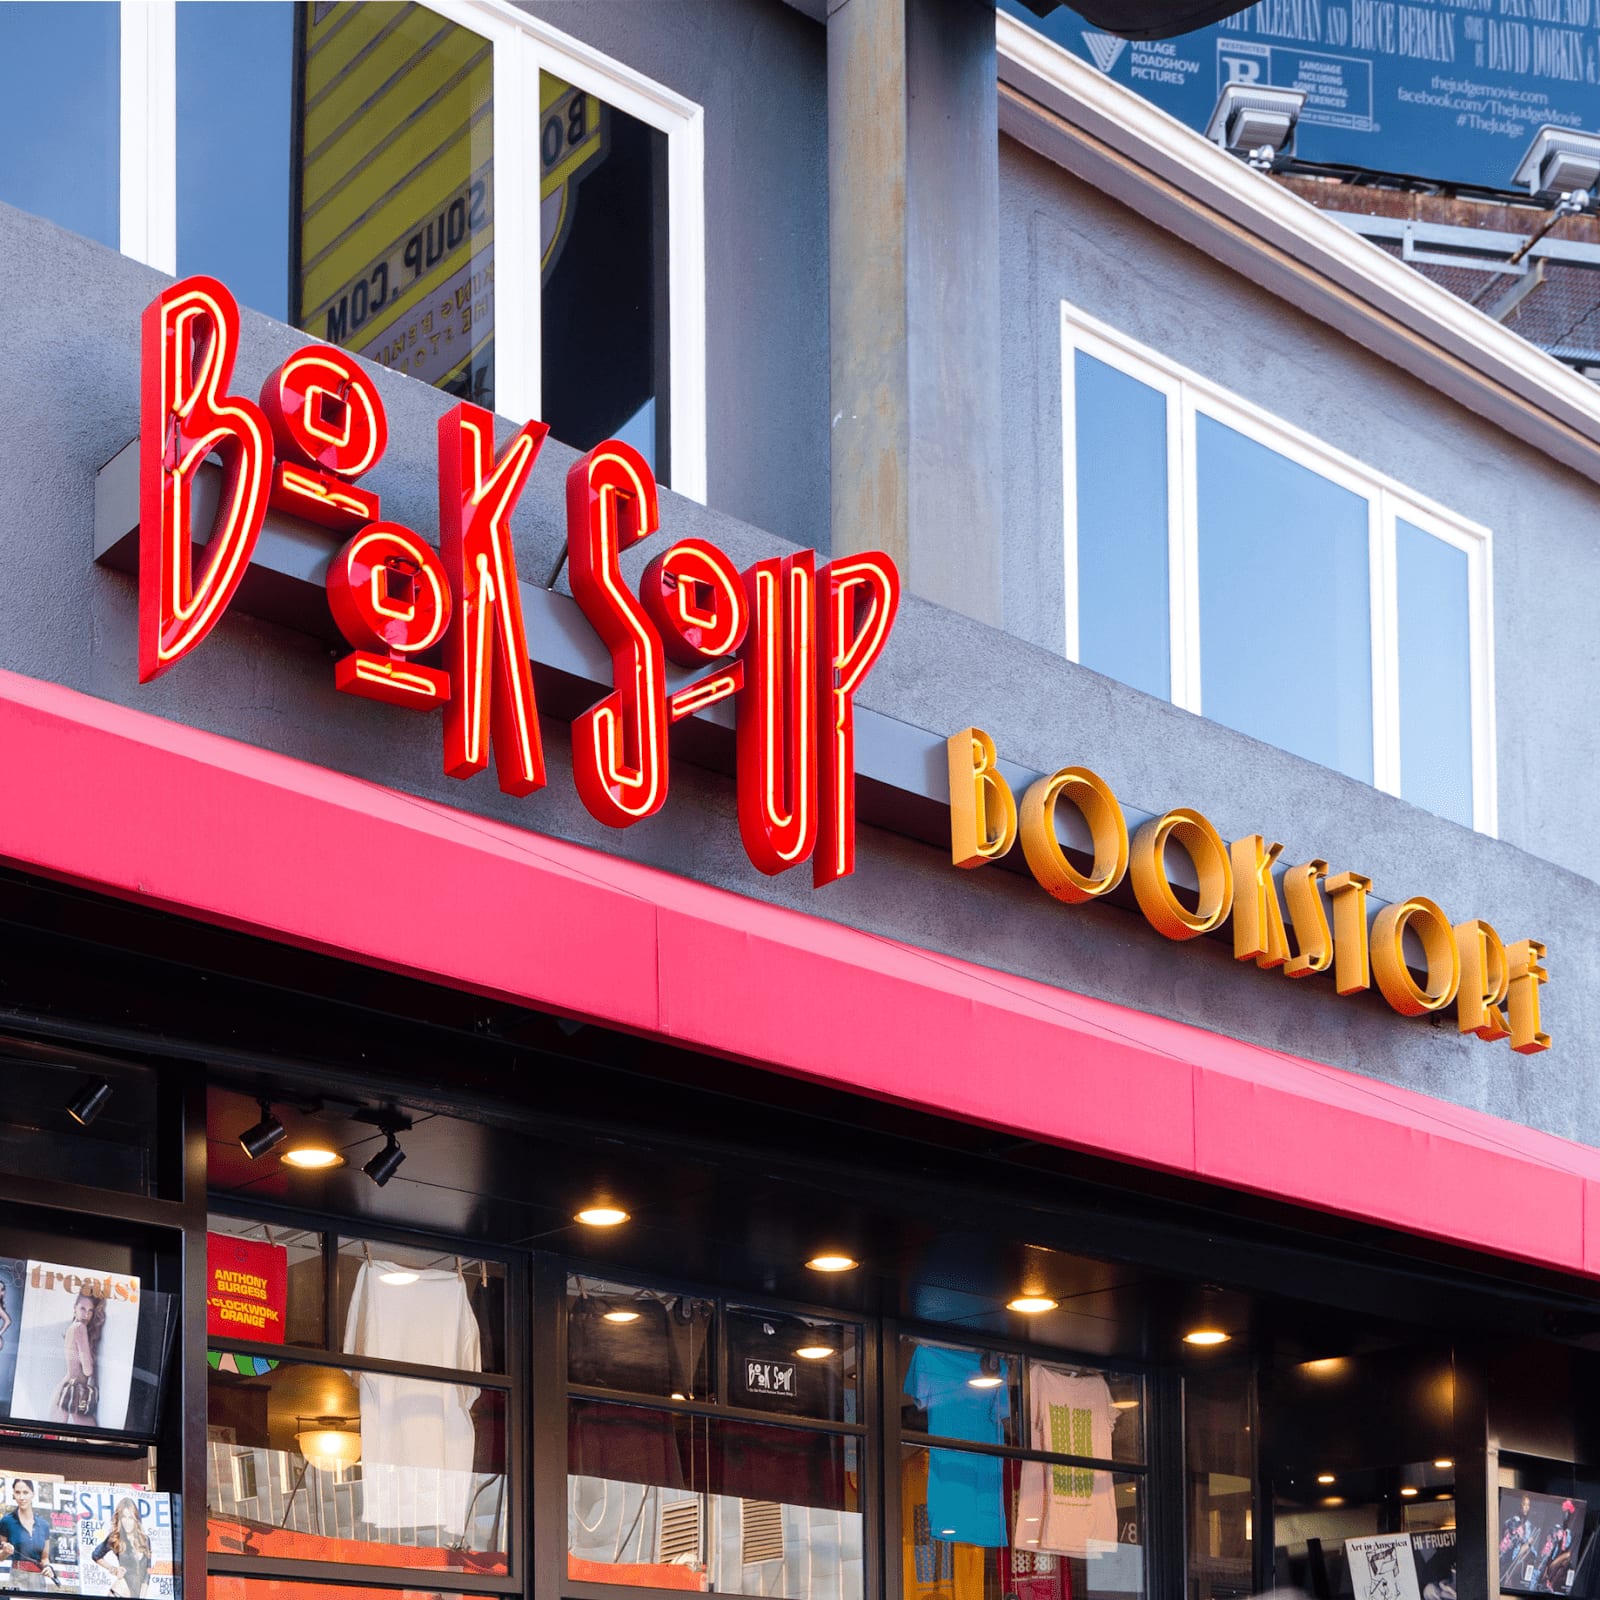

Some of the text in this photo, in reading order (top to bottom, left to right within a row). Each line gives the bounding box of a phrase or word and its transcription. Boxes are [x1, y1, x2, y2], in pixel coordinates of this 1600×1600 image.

[1351, 0, 1396, 54] BRUCE
[1398, 4, 1456, 63] BERMAN
[1130, 40, 1177, 56] VILLAGE
[1488, 19, 1529, 74] DAVID
[1533, 25, 1584, 82] DOBKIN
[1130, 52, 1200, 73] ROADSHOW
[1299, 60, 1342, 74] LANGUAGE
[1130, 66, 1185, 85] PICTURES
[1298, 71, 1343, 86] INCLUDING
[1318, 83, 1348, 97] SEXUAL
[1431, 75, 1549, 104] thejudgemovie.com
[946, 726, 1553, 1056] BOOKSTORE
[30, 1264, 139, 1304] treats!
[214, 1269, 268, 1289] ANTHONY
[217, 1280, 268, 1300] BURGESS
[211, 1297, 280, 1322] CLOCKWORK
[220, 1308, 266, 1329] ORANGE
[80, 1492, 170, 1527] SHPE
[81, 1521, 105, 1530] BELLY
[82, 1529, 94, 1538] FAT
[82, 1538, 98, 1546] FIX!
[1350, 1540, 1408, 1552] Art in America
